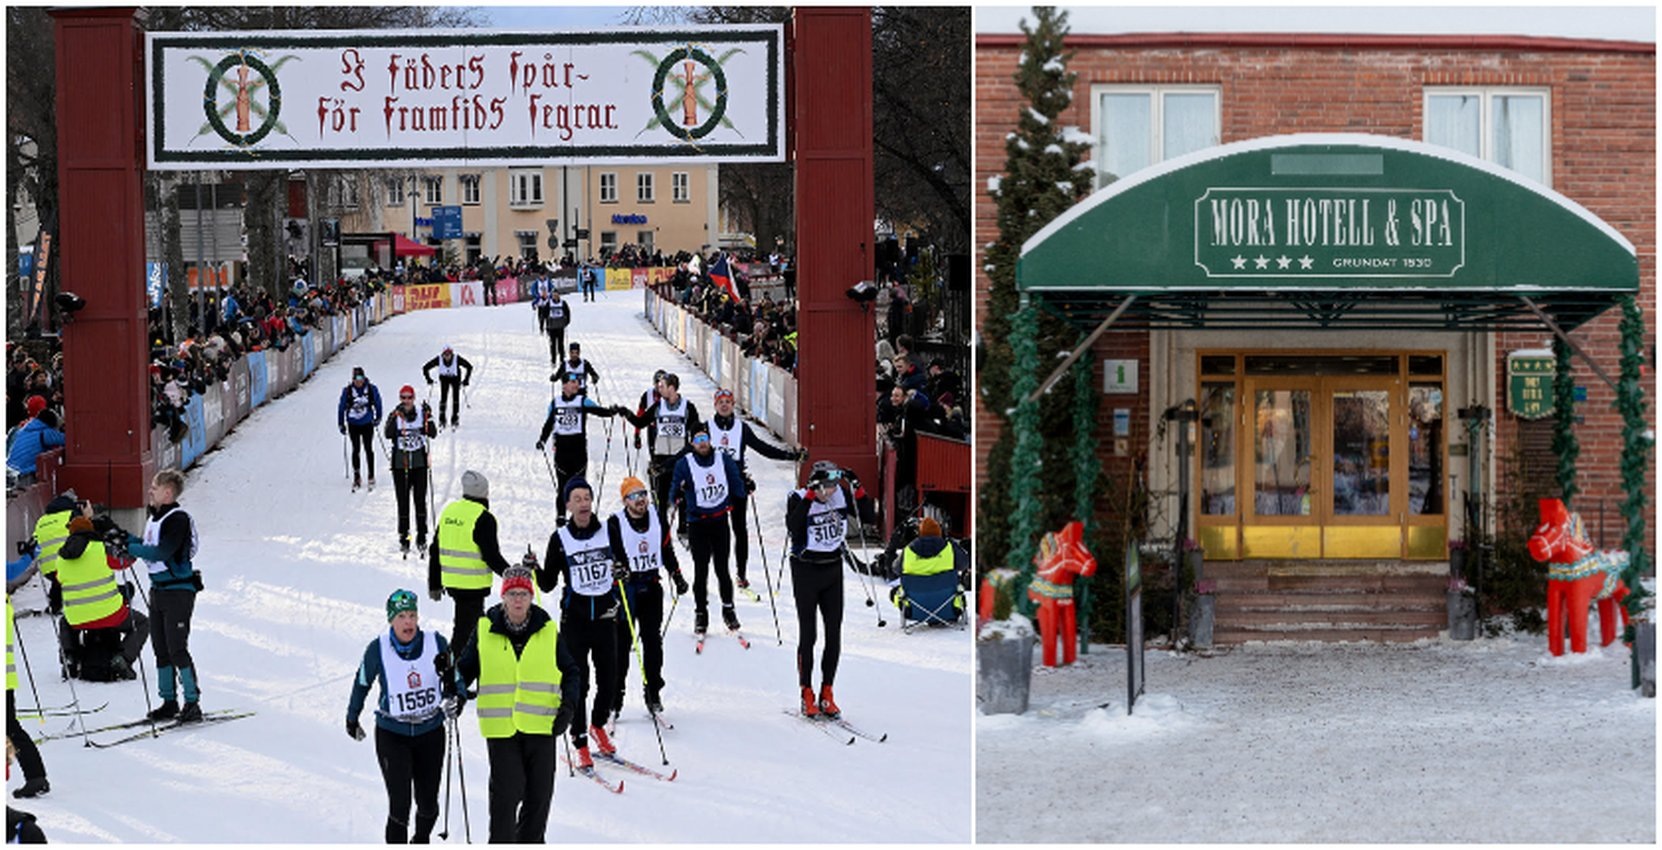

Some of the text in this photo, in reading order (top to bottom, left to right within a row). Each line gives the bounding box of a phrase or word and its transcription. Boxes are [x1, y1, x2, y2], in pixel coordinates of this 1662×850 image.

[1210, 198, 1453, 246] MORA HOTELL & SPA
[1332, 258, 1398, 268] GRUNDAT
[577, 562, 608, 583] 1167
[396, 687, 436, 712] 1556
